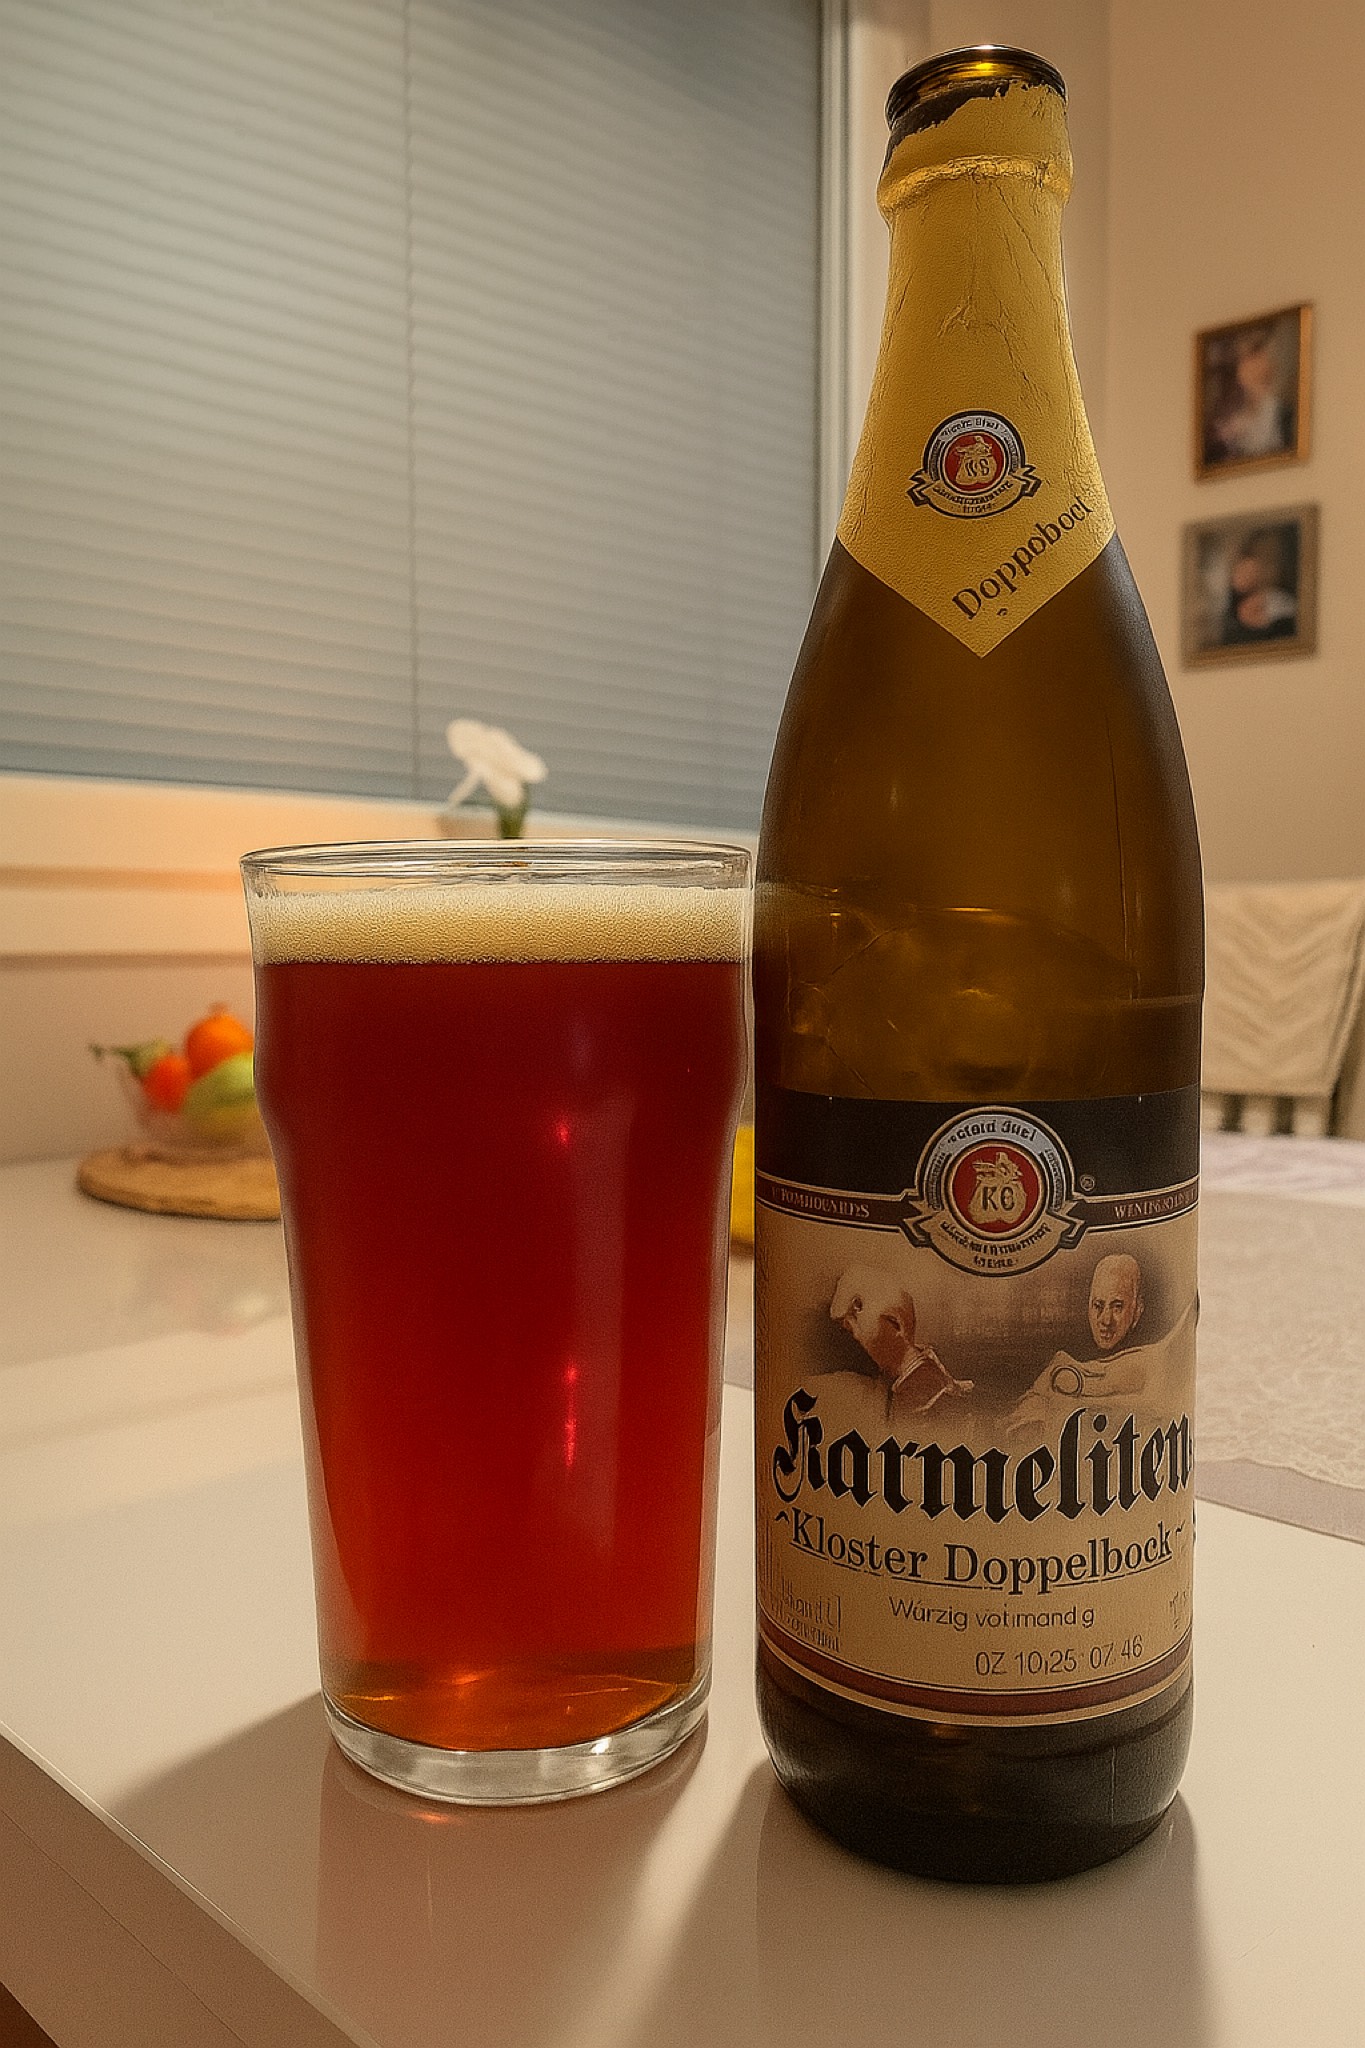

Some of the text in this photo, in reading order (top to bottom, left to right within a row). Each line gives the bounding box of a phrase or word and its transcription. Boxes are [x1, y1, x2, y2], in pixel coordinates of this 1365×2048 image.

[773, 1388, 1193, 1523] Karmeliten
[790, 1509, 1172, 1595] Kloster Doppelbock
